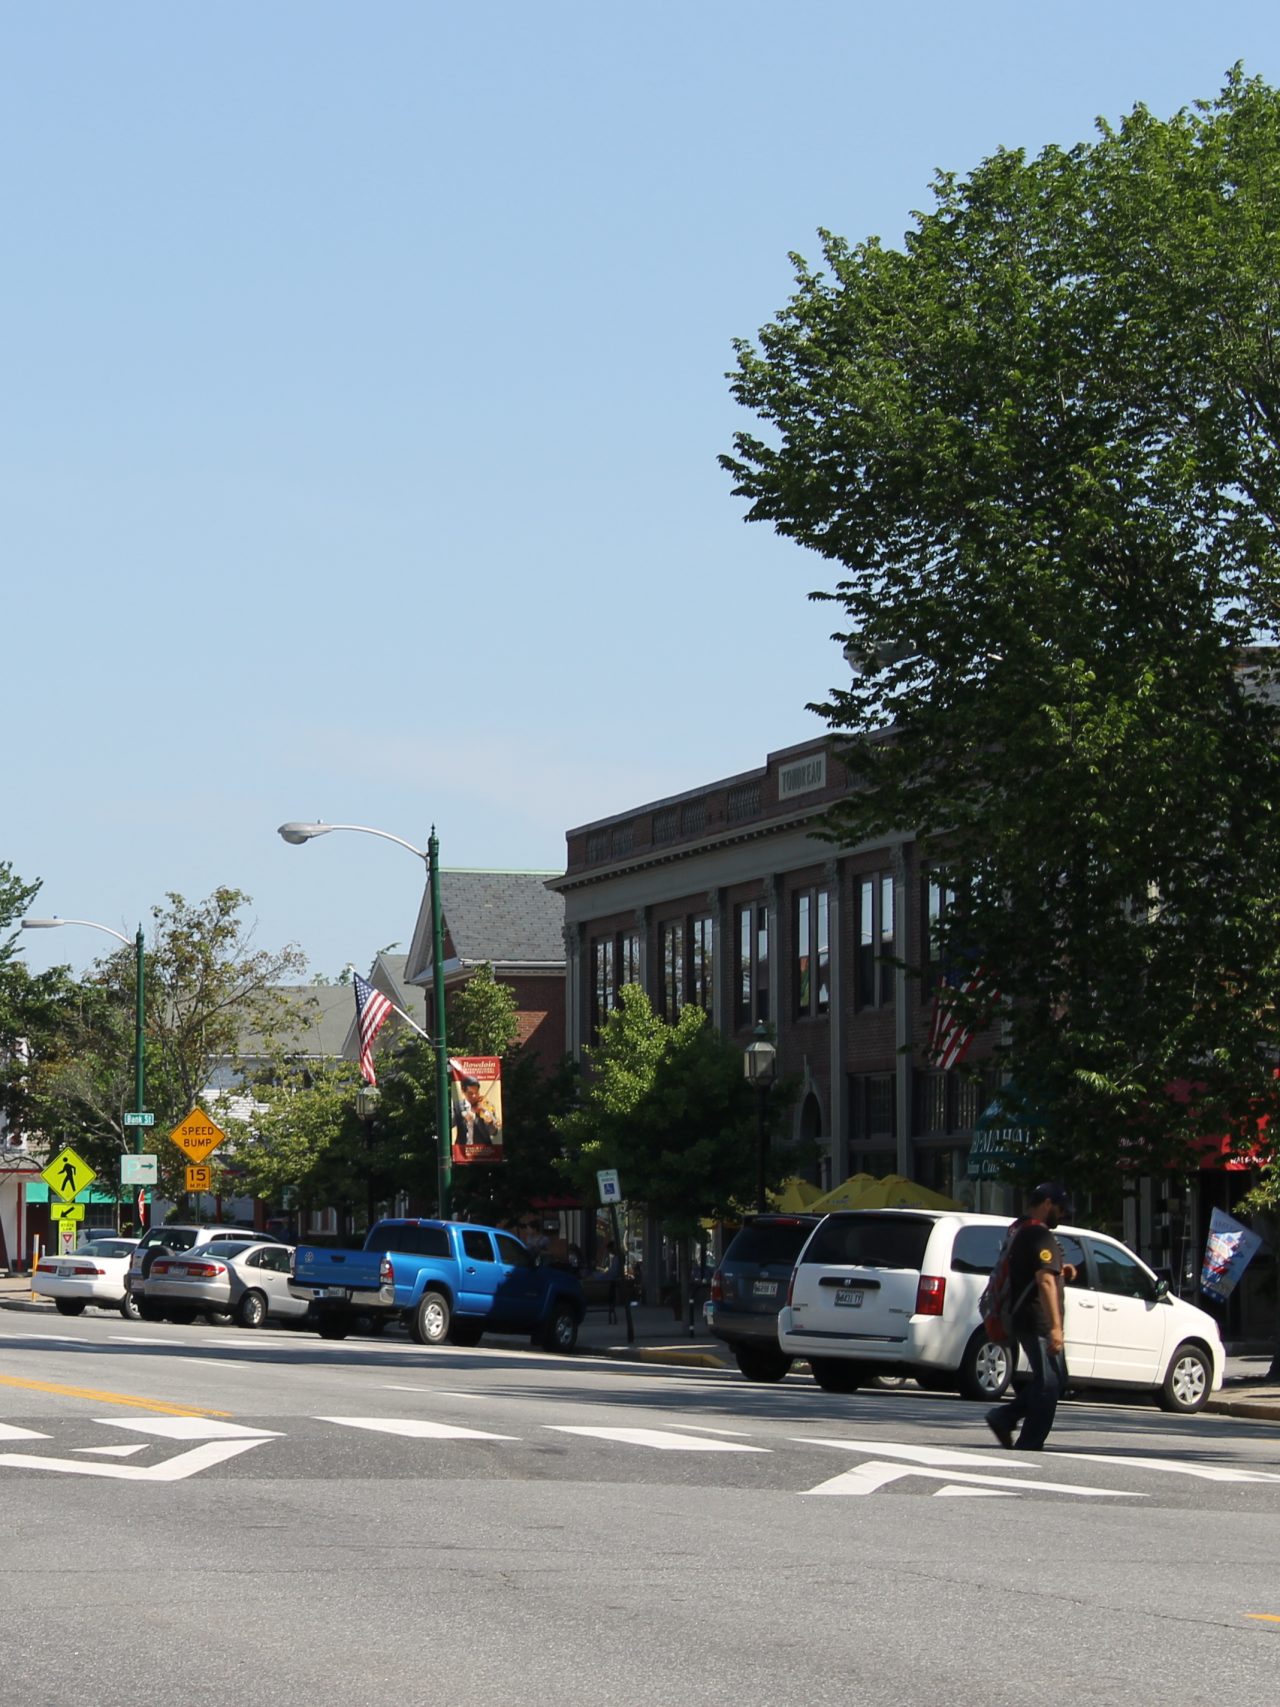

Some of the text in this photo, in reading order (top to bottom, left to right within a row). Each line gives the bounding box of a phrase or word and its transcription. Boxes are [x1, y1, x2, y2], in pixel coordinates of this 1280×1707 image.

[126, 1114, 152, 1124] Bank St
[182, 1127, 214, 1136] SPEED
[183, 1138, 212, 1148] BUMP
[190, 1169, 206, 1181] 15
